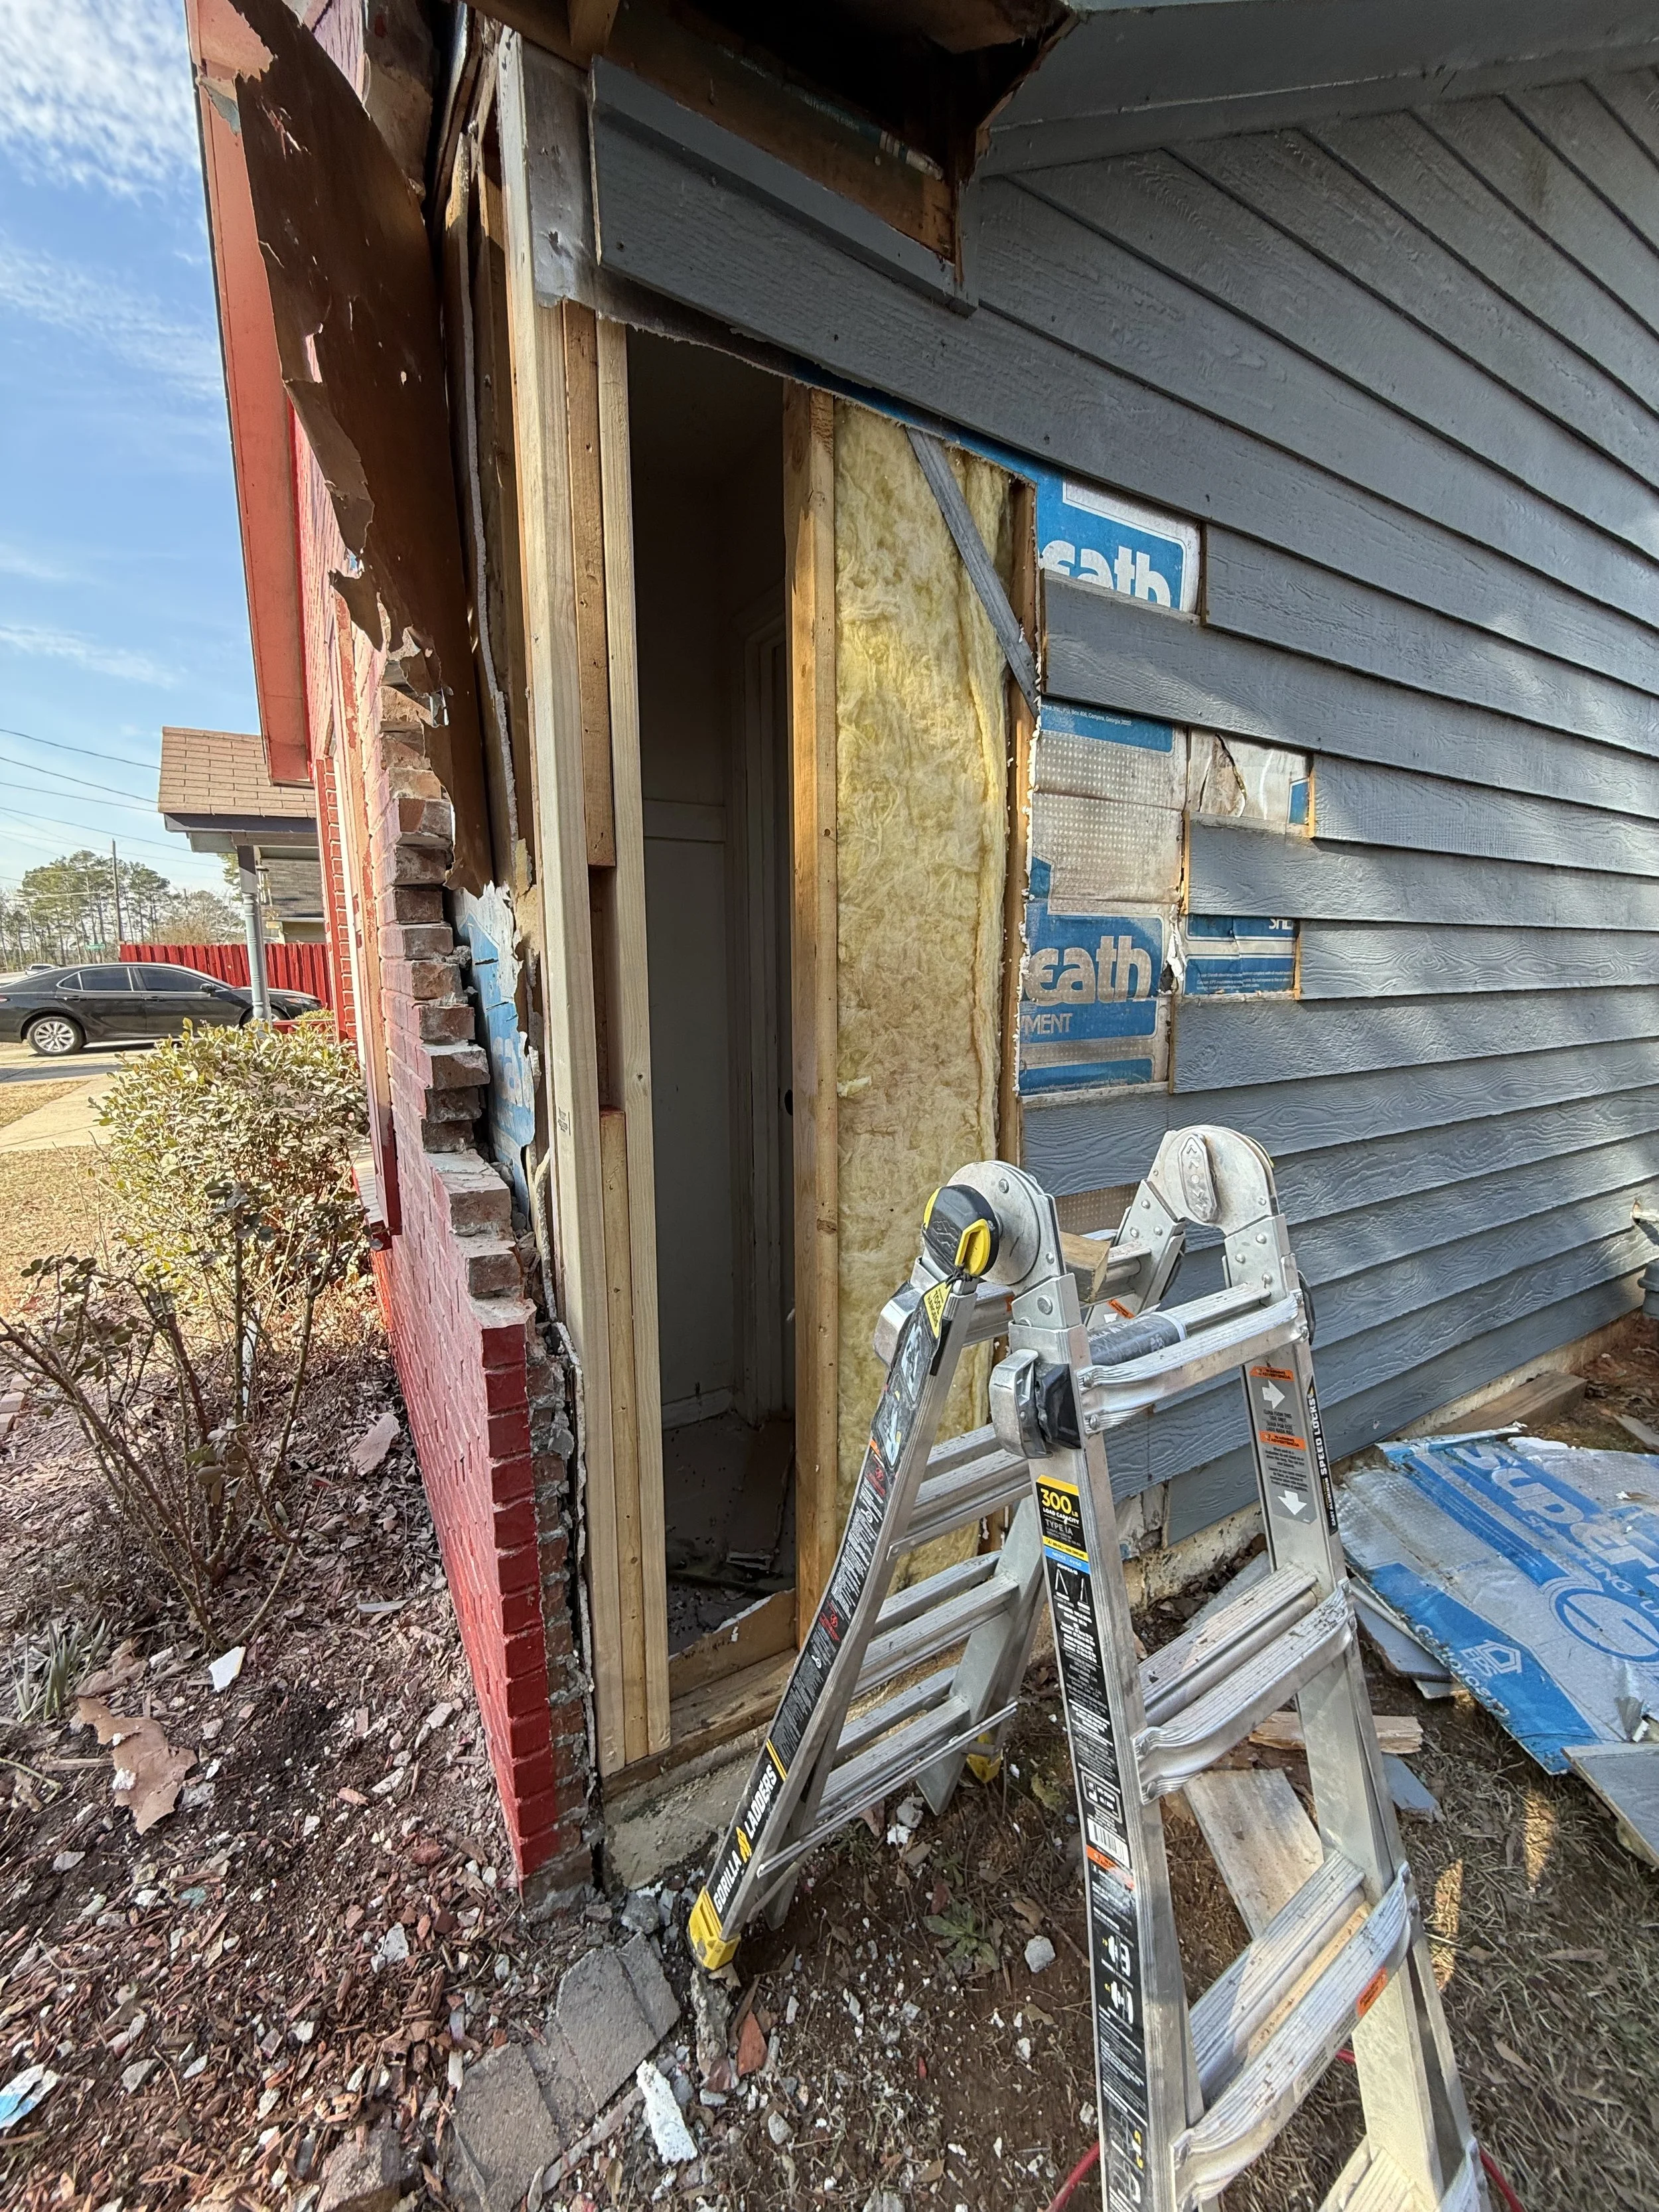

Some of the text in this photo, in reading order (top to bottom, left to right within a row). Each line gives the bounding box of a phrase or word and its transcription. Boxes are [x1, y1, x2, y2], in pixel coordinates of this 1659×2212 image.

[933, 1290, 942, 1315] TOOL
[1309, 1398, 1321, 1436] LOCKS
[1315, 1436, 1327, 1476] SPEED
[1041, 1488, 1072, 1514] 300
[1043, 1507, 1079, 1524] LOAD CAPACITY
[1045, 1518, 1064, 1532] TYPE
[1460, 1648, 1493, 1677] EPS
[713, 1764, 777, 1914] GORILLA LADDERS
